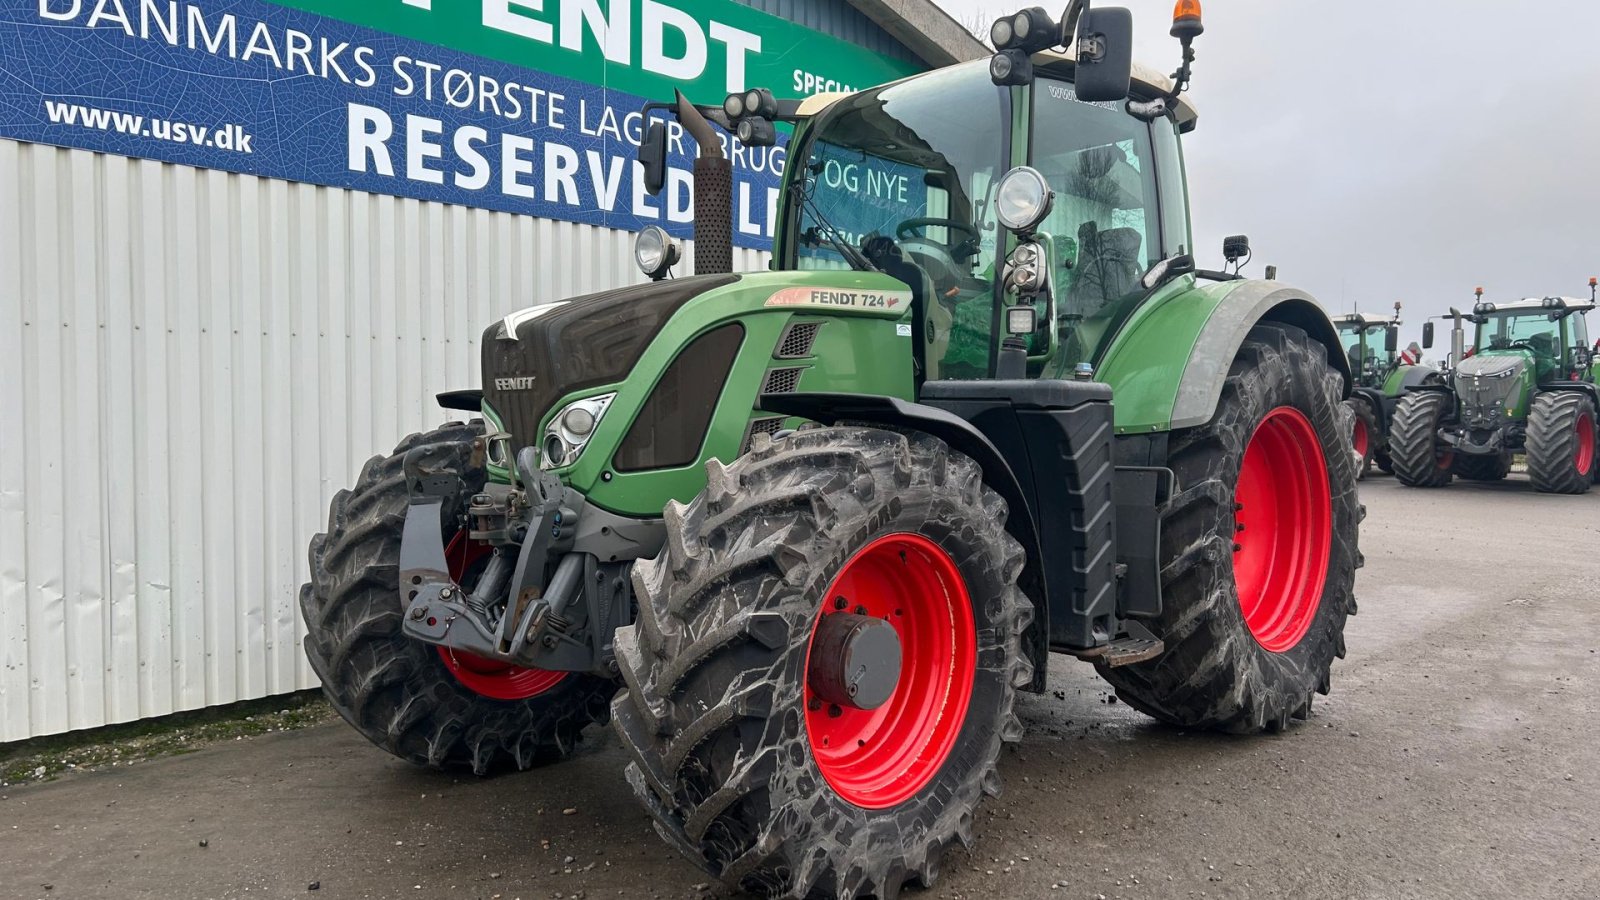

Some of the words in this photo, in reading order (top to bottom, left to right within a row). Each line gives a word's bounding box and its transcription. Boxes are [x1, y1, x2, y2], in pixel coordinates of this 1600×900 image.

[402, 0, 761, 93] ENDT
[45, 101, 253, 154] www.usv.dk
[393, 56, 565, 130] STØRSTE
[824, 159, 858, 192] OG
[867, 168, 908, 203] NYE
[811, 290, 857, 306] FENDT
[861, 294, 884, 307] 724
[494, 376, 536, 391] FENDT
